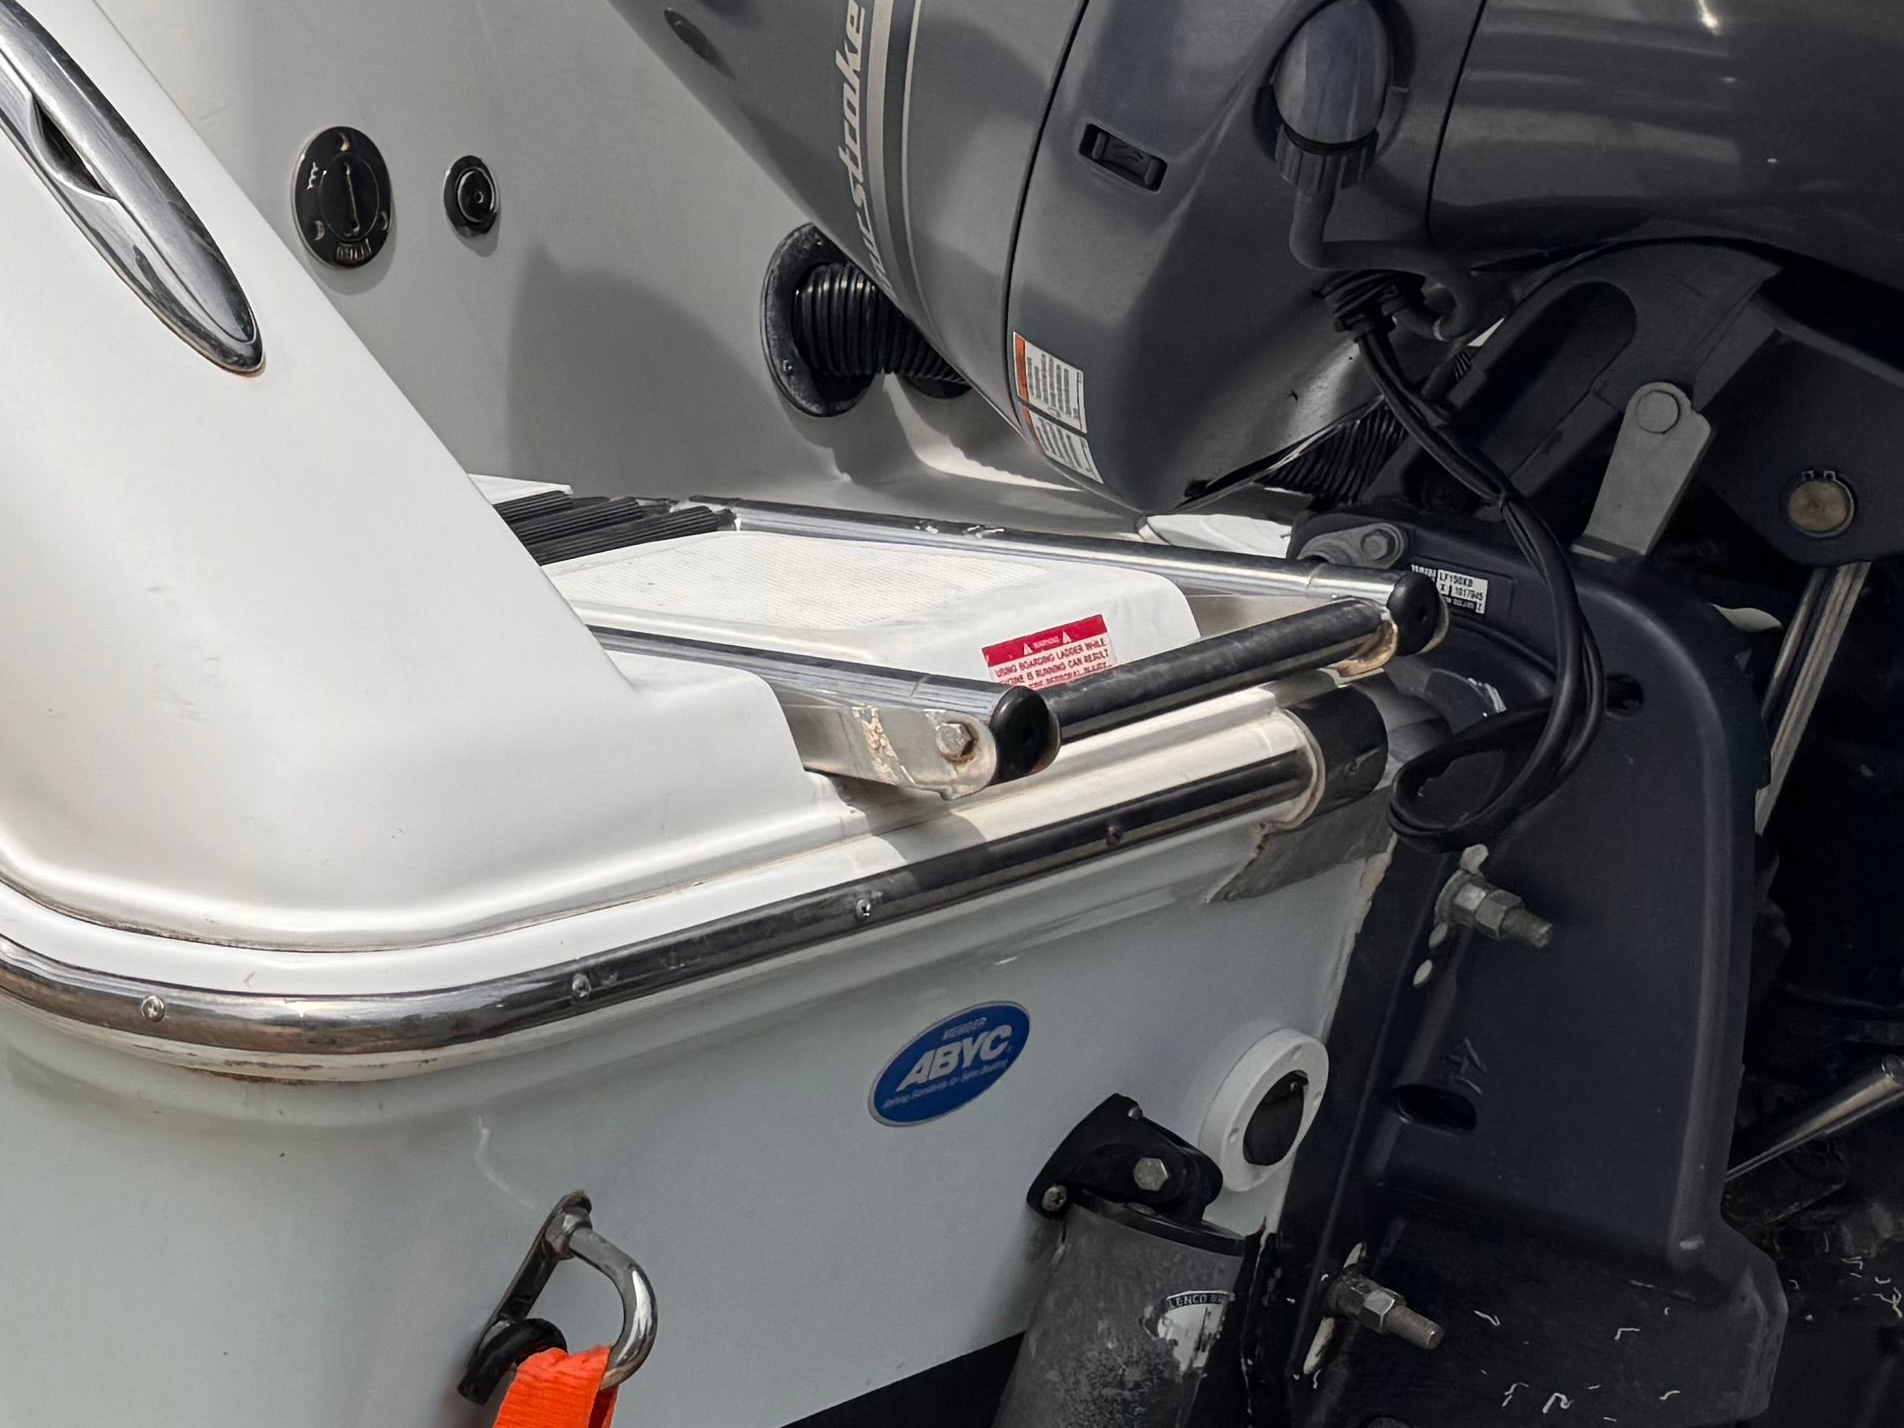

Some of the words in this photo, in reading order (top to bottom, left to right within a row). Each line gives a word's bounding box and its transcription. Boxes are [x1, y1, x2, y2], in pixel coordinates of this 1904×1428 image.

[995, 663, 1018, 678] USING
[1019, 653, 1055, 672] BOARDING
[1056, 644, 1084, 659] LADDER
[1085, 637, 1107, 651] WHILE
[1035, 664, 1067, 679] RUNNING
[1067, 656, 1084, 669] CAN
[1083, 649, 1110, 664] RESULT
[895, 1023, 1013, 1093] ABYC
[1168, 1294, 1208, 1309] LENCO
